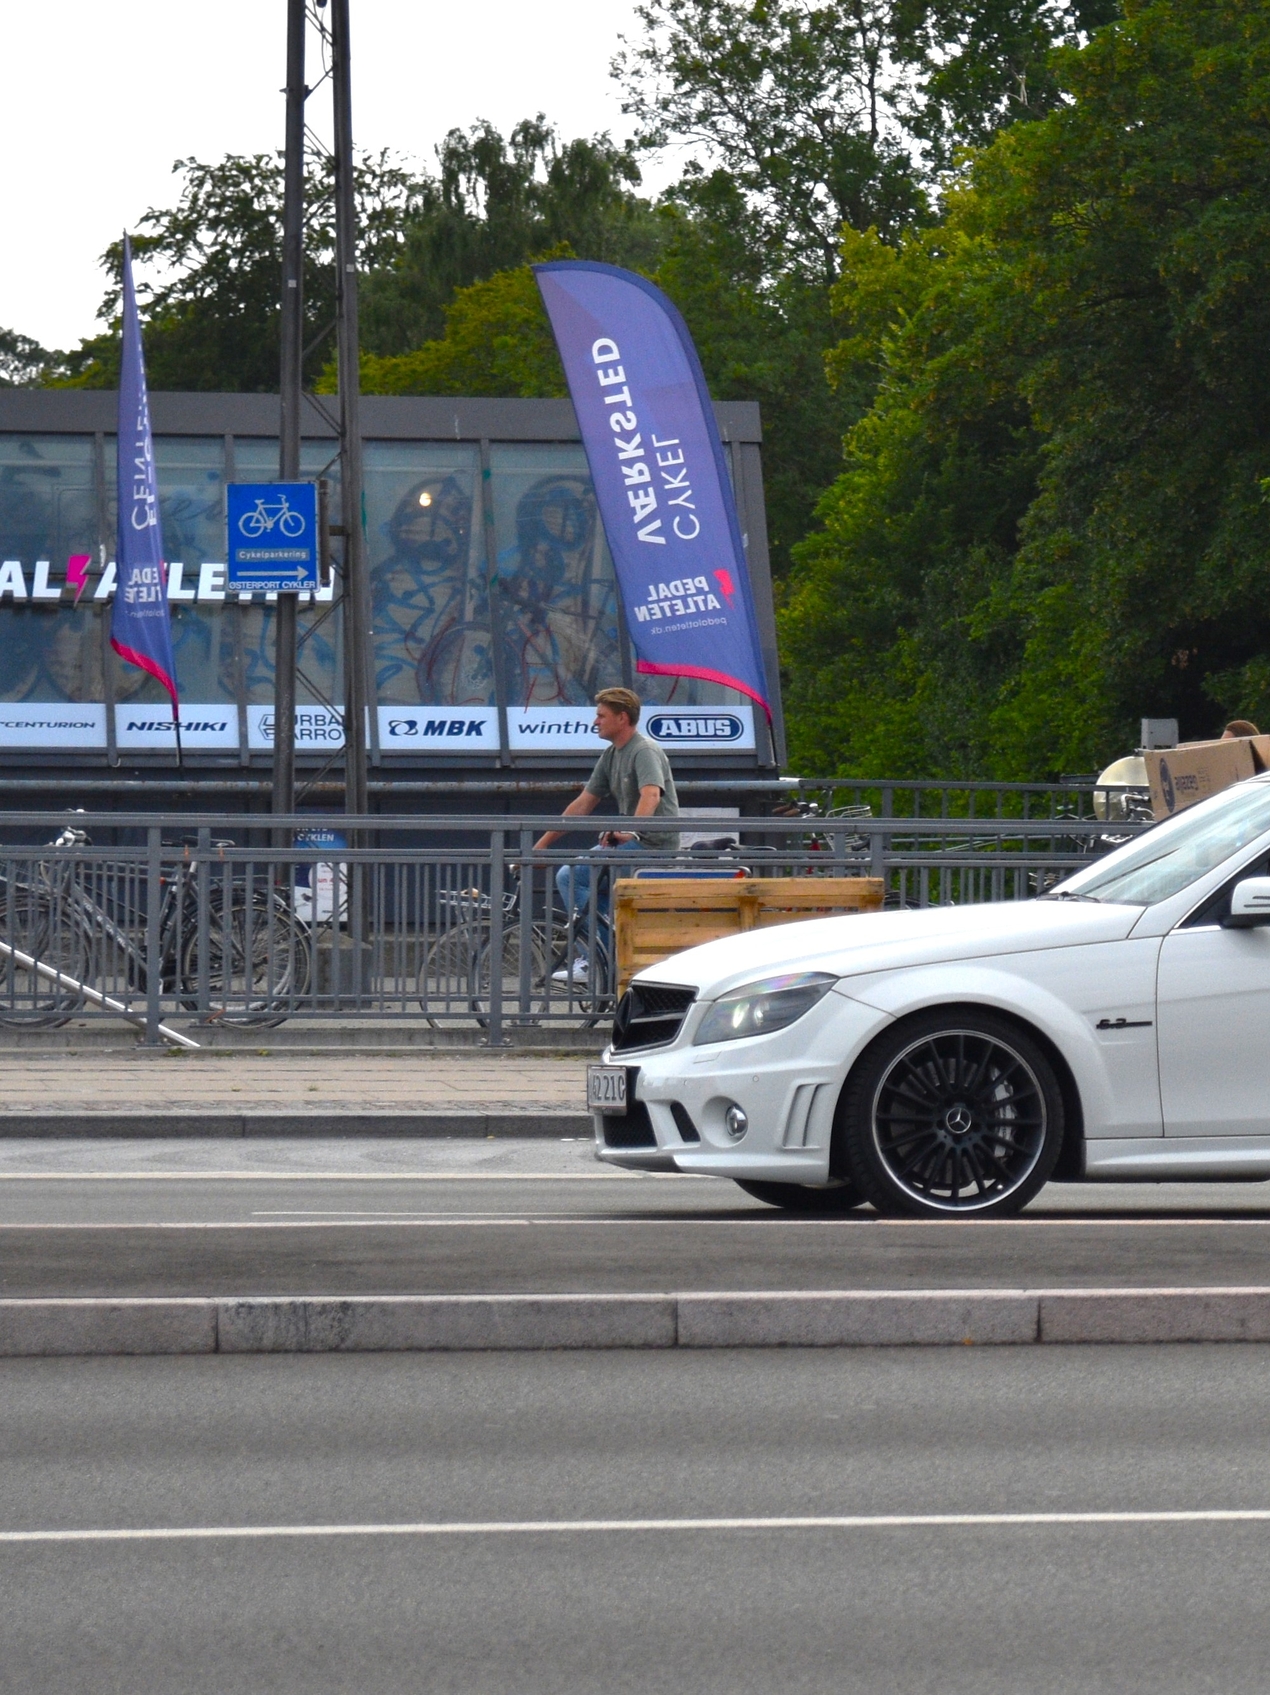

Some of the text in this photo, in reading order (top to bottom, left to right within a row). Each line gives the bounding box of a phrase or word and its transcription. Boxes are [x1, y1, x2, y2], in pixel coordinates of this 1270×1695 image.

[239, 550, 306, 560] Cykelparkering
[229, 581, 315, 590] ØSTERPORT CYKLER
[126, 721, 228, 732] NISHIKI
[422, 720, 488, 736] MBK
[518, 721, 600, 735] winthe
[659, 719, 731, 736] ABUS
